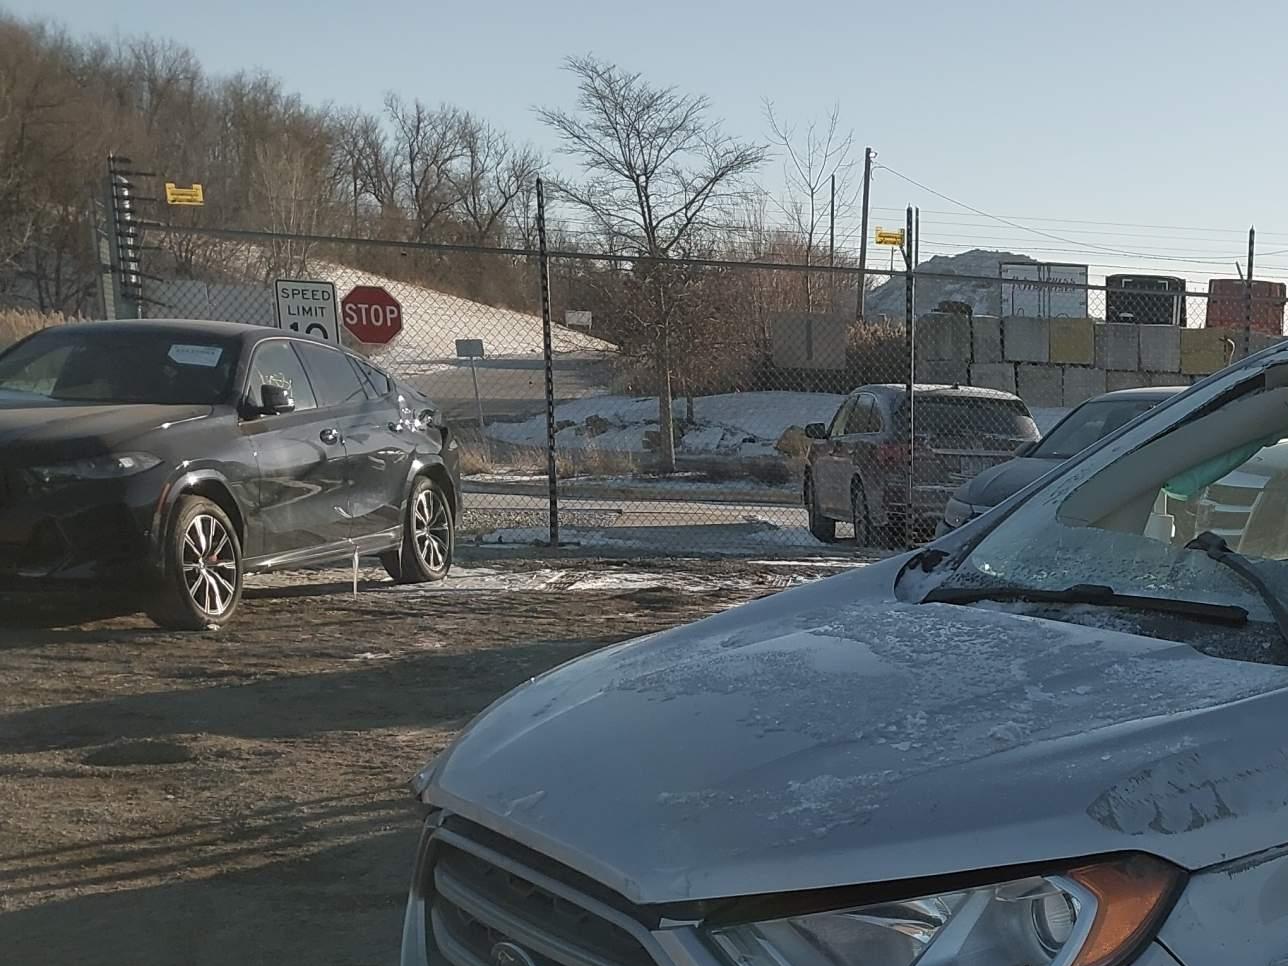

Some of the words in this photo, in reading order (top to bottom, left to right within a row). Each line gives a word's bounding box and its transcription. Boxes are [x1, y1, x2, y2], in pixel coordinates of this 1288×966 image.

[281, 288, 330, 300] SPEED
[288, 305, 326, 317] LIMIT
[345, 304, 398, 326] STOP
